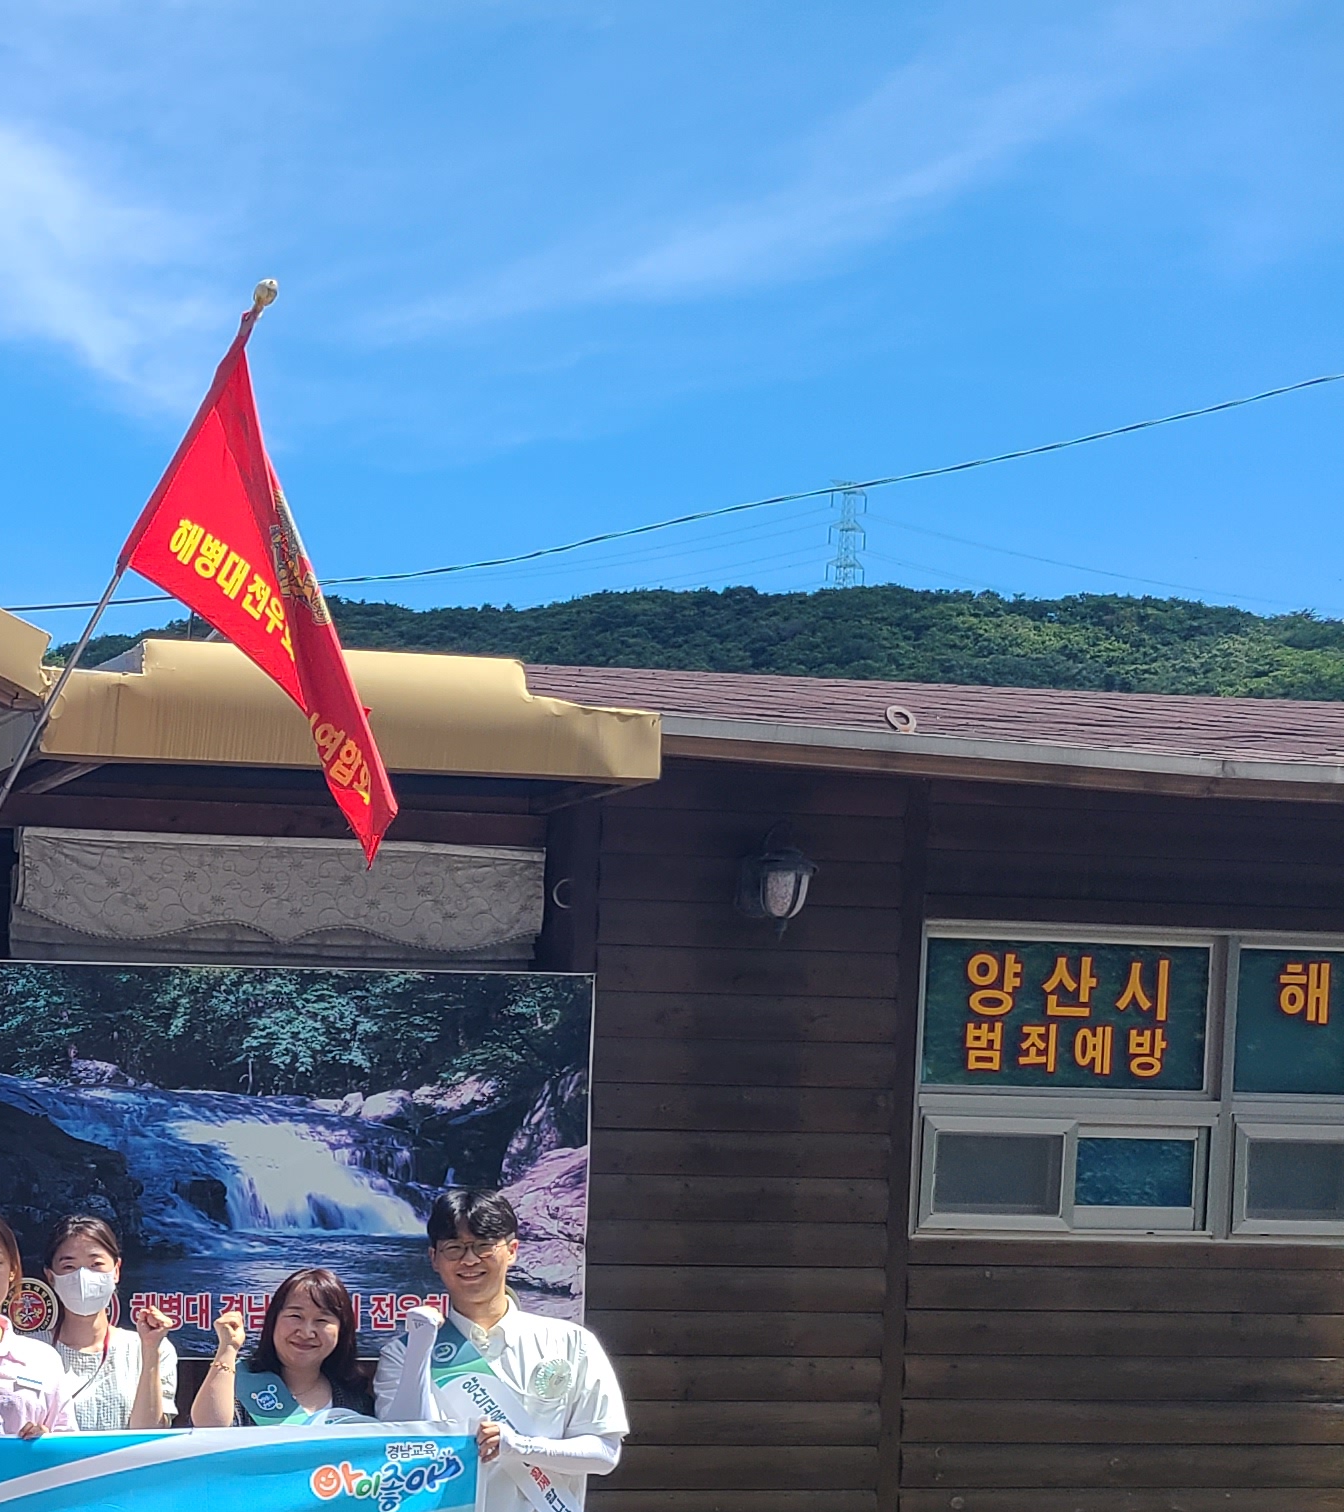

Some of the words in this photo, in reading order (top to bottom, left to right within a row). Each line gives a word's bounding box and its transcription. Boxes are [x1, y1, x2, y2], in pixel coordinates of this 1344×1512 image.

[169, 518, 251, 600] 해병대
[966, 953, 1170, 1021] 양산시
[1278, 962, 1331, 1025] 해
[965, 1021, 1168, 1078] 범죄예방
[387, 1443, 436, 1460] 경남교육
[313, 1462, 462, 1512] 아이좋아
